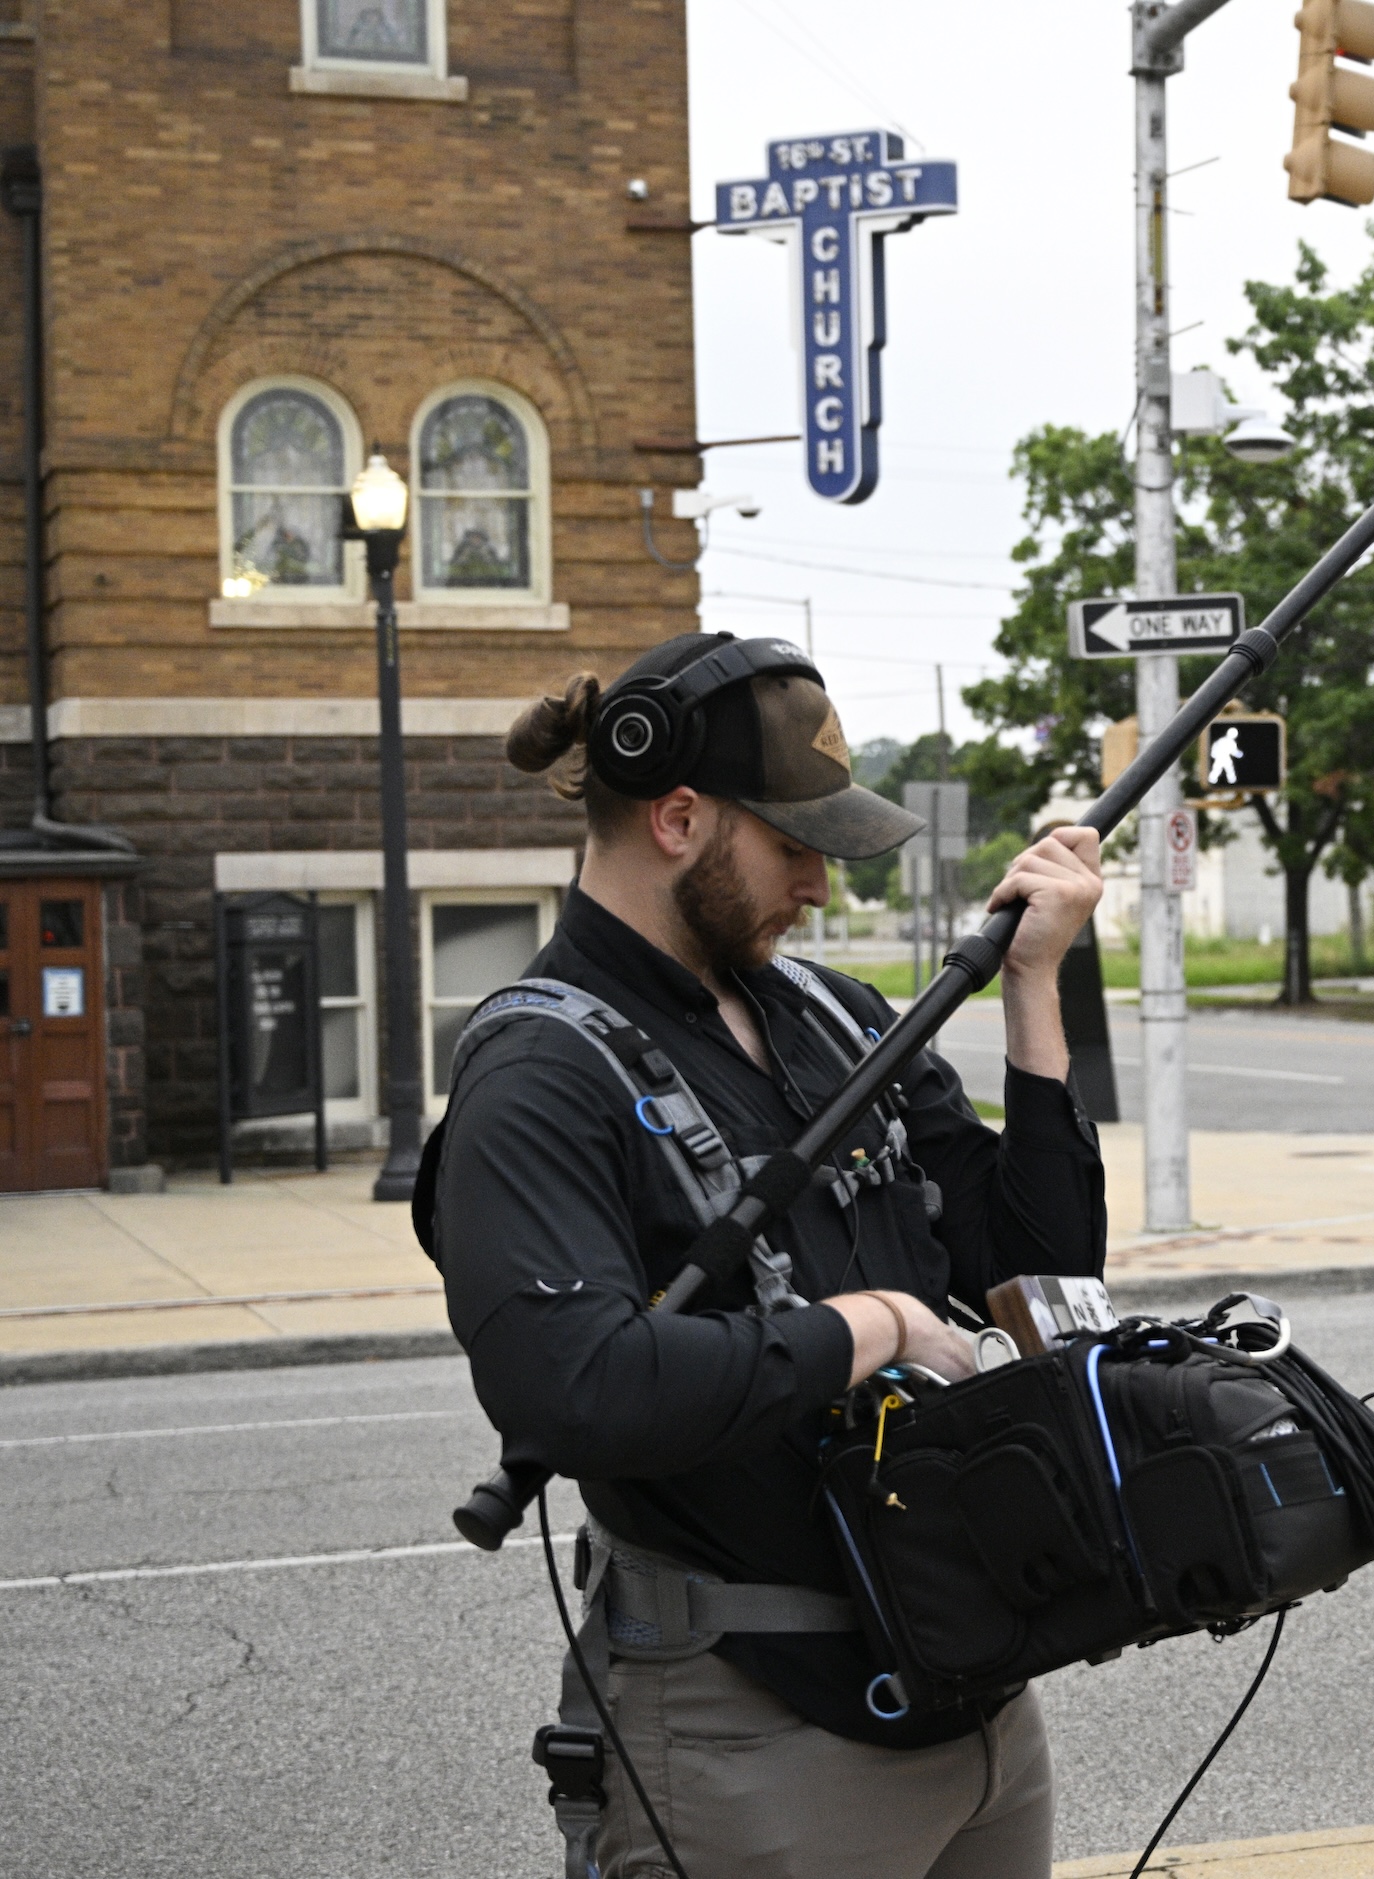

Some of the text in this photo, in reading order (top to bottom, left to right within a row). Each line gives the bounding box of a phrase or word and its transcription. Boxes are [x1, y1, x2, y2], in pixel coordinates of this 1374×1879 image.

[828, 136, 874, 165] ST.
[730, 168, 923, 220] BAPTIST
[811, 226, 845, 475] CHURCH
[1130, 613, 1225, 637] ONE WAY
